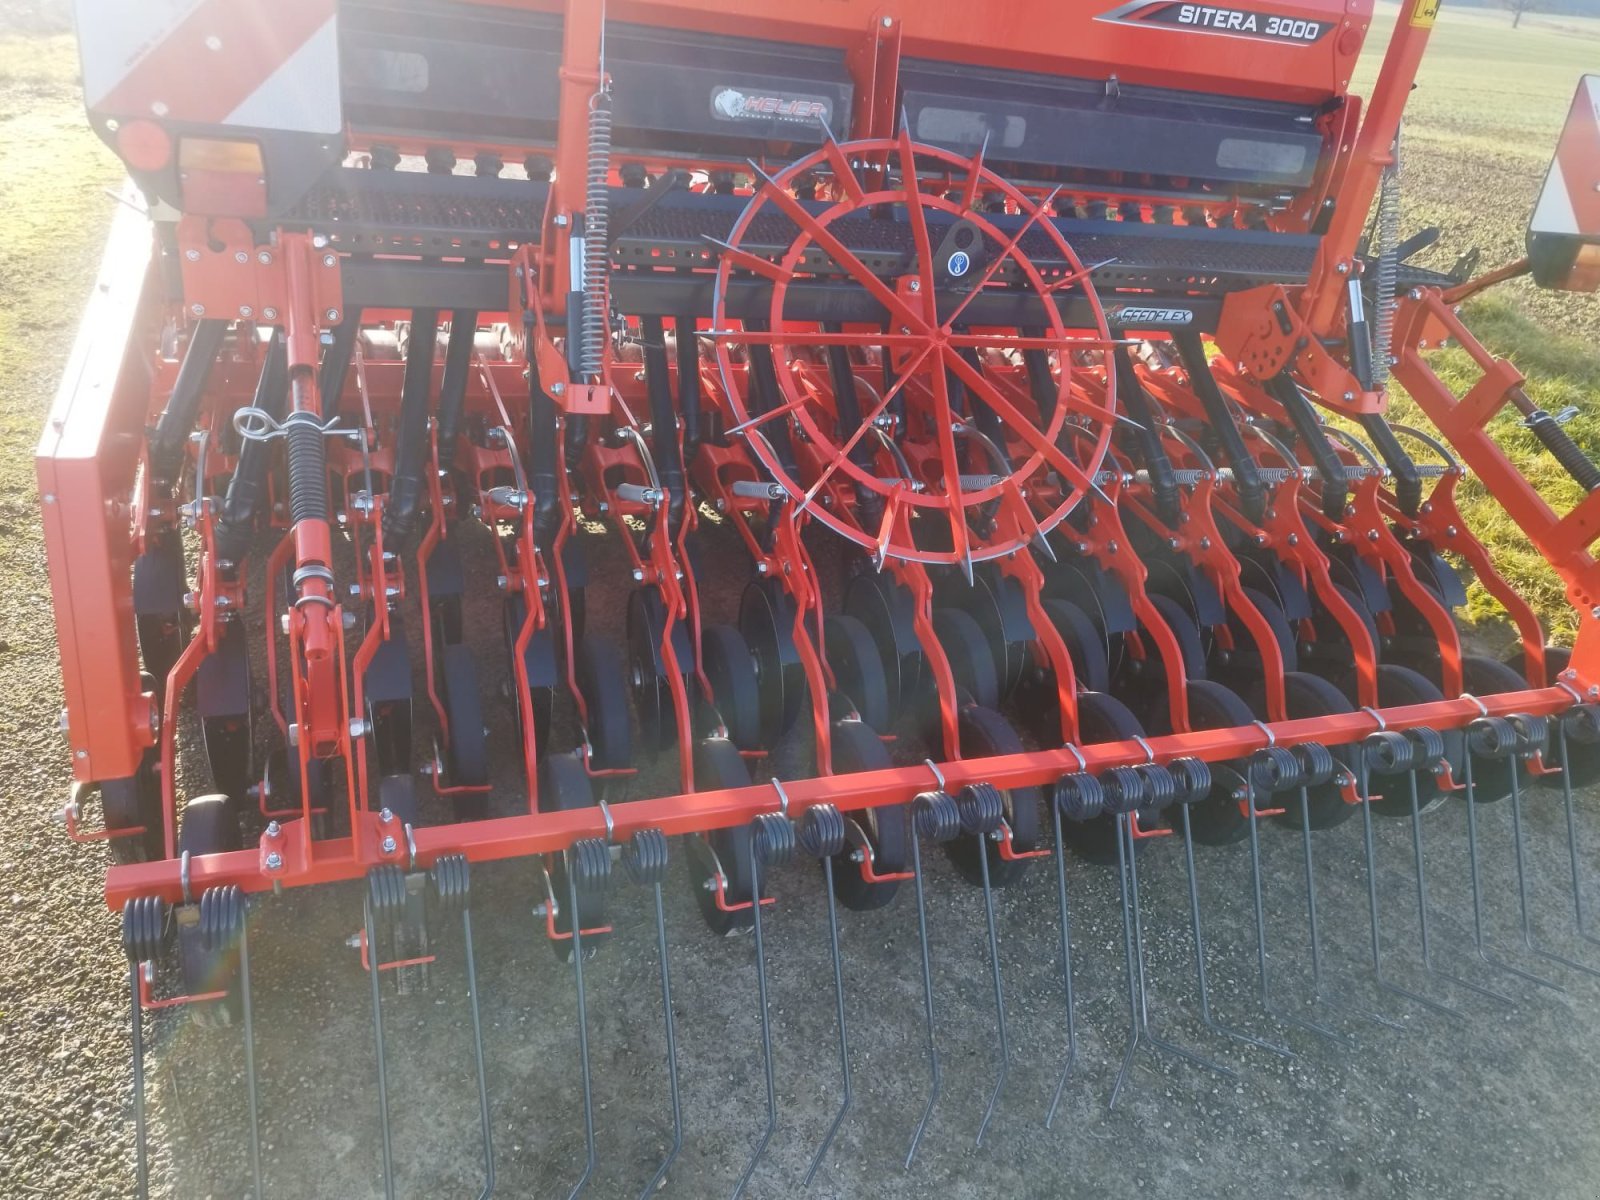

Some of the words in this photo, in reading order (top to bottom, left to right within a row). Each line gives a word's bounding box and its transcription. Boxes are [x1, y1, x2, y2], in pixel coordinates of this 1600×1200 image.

[1178, 5, 1257, 32] SITERA
[1265, 17, 1320, 40] 3000
[1120, 309, 1190, 323] SEEDFLEX
